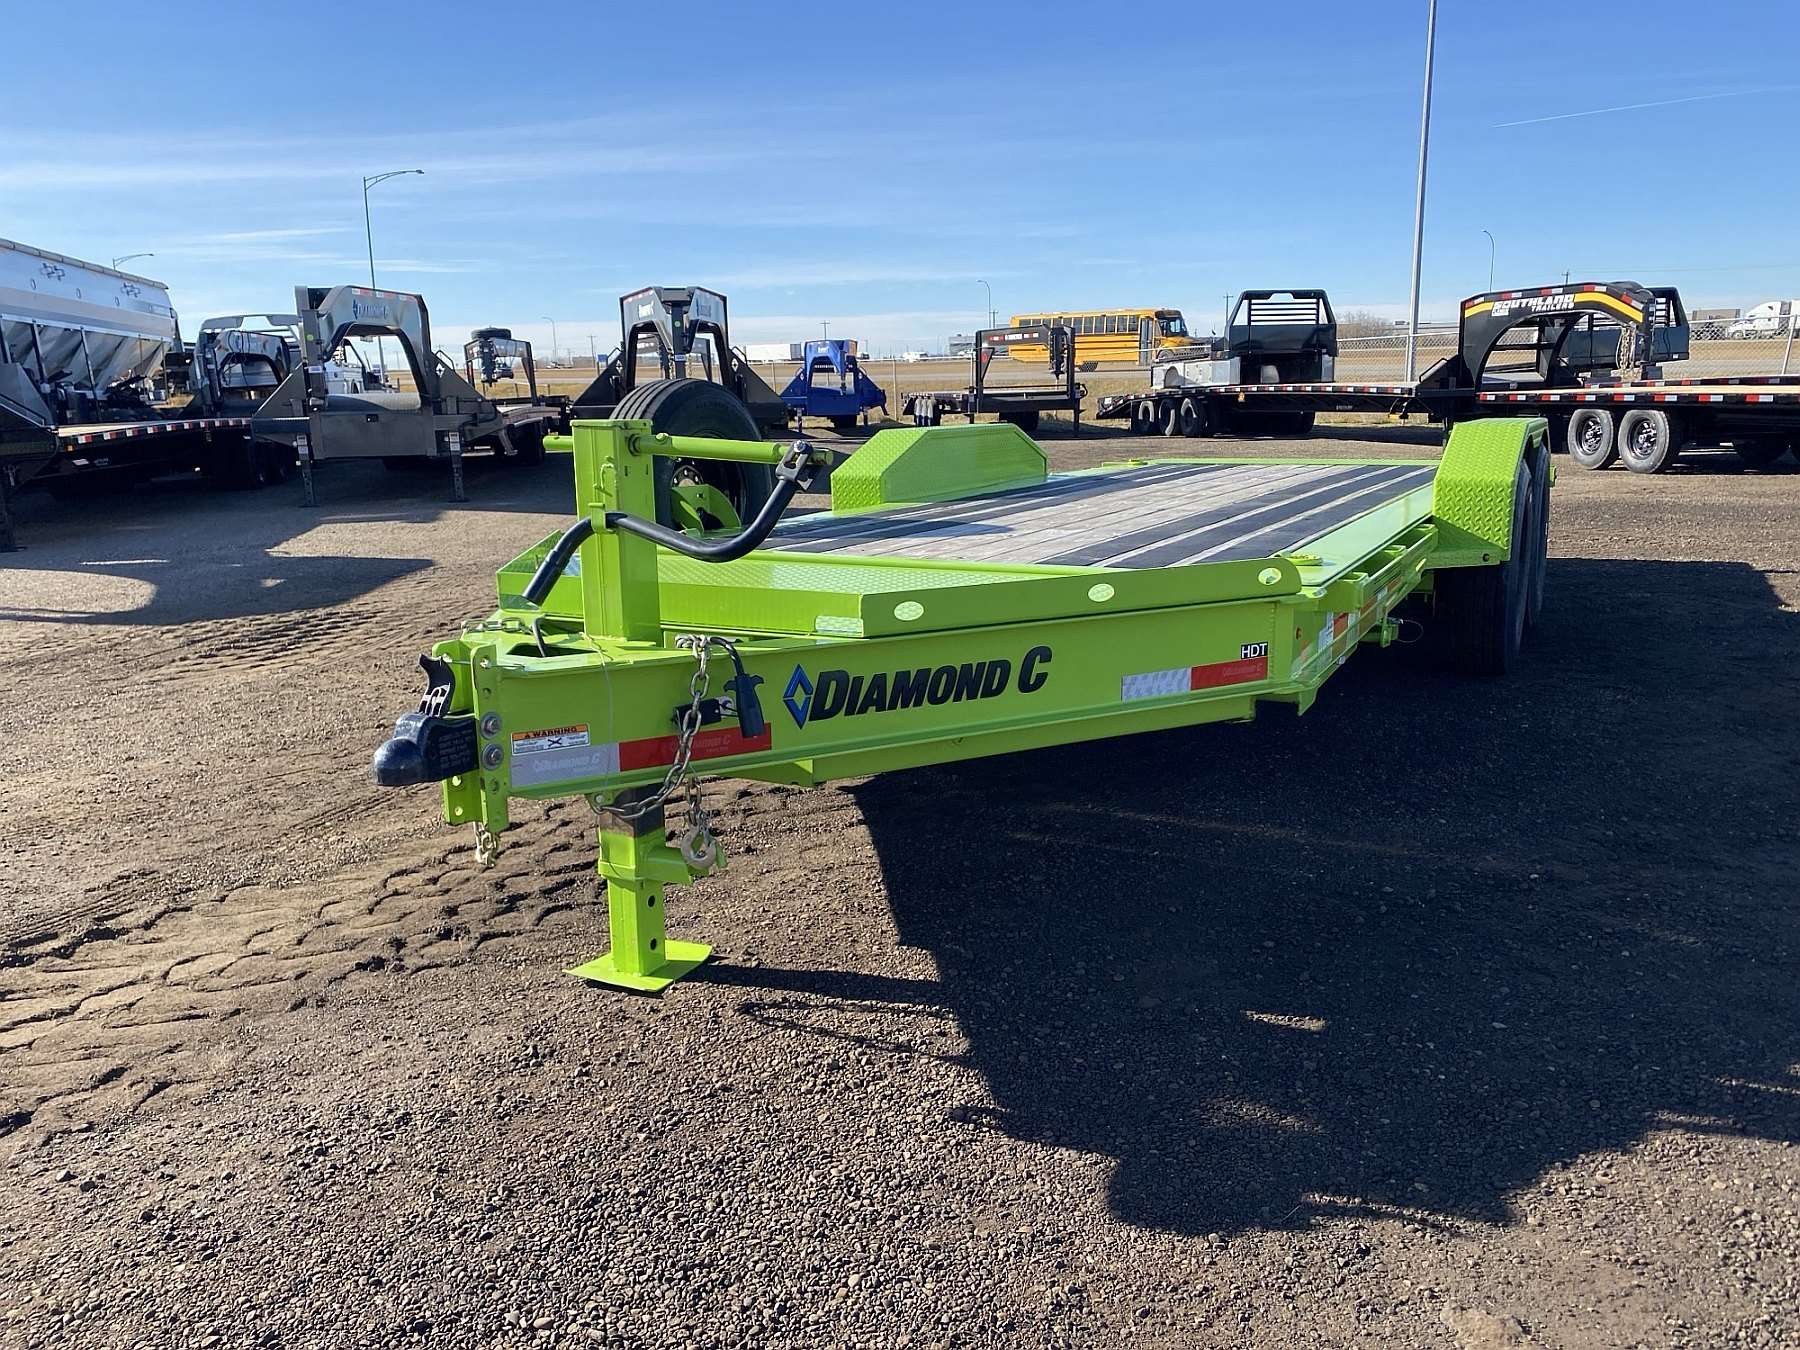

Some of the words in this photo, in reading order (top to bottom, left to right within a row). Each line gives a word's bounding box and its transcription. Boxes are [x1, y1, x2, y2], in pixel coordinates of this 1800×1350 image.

[1493, 293, 1575, 310] SOUTHLAND
[1531, 302, 1575, 312] TRAILERS
[1241, 643, 1268, 659] HDT
[808, 659, 1012, 722] DIAMOND
[1017, 645, 1053, 694] C
[532, 726, 578, 738] WARNING
